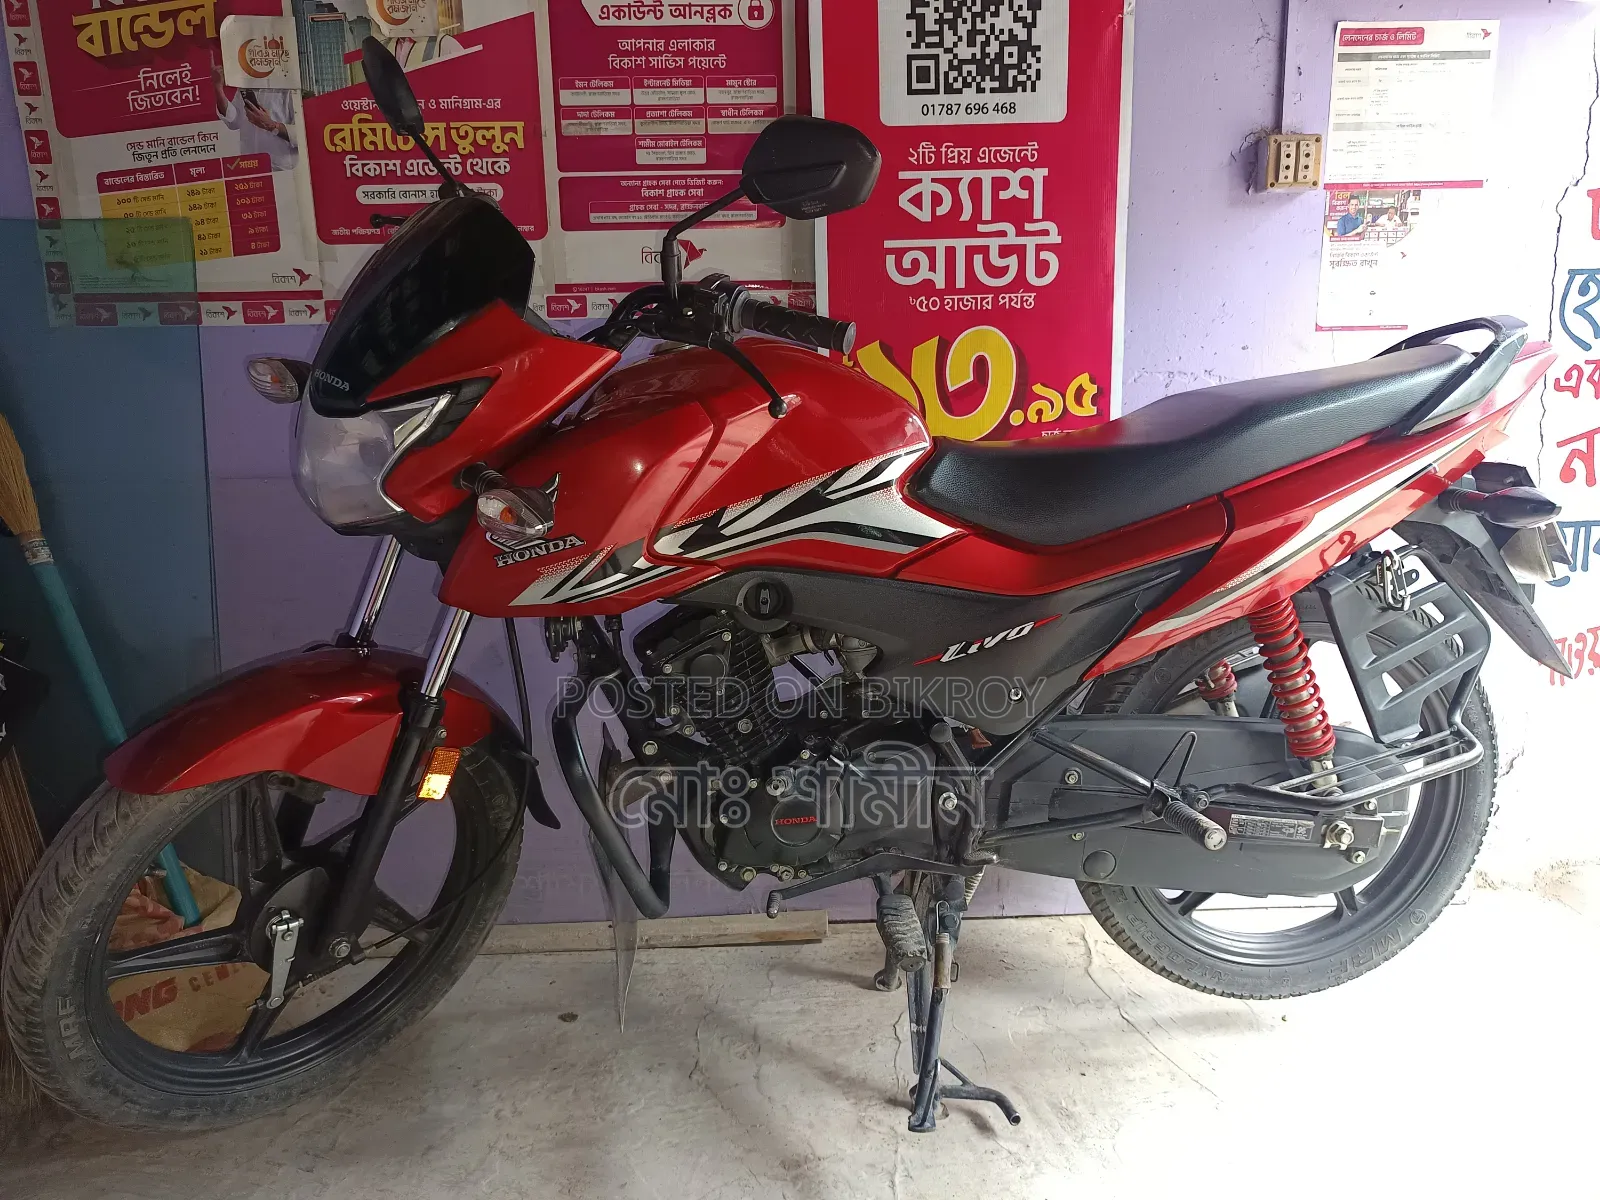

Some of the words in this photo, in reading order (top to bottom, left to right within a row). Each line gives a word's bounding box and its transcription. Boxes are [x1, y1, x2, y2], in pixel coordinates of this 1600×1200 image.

[598, 0, 664, 20] একাউন্ট
[668, 2, 734, 23] আনব্লক
[72, 0, 217, 57] বান্ডেল
[618, 38, 665, 52] আপনার
[668, 38, 716, 52] এলাকার
[608, 54, 646, 69] বিকাশ
[648, 54, 685, 68] সার্ভিস
[688, 54, 726, 70] পয়েন্টে
[138, 62, 191, 91] নিলেই
[127, 85, 200, 112] জিতবেন!
[439, 96, 501, 110] মানিগ্রাম-এর
[922, 103, 961, 116] 01787
[965, 102, 989, 115] 696
[992, 102, 1017, 115] 468
[126, 141, 144, 152] সেন্ড
[146, 136, 165, 150] মানি
[168, 134, 194, 147] বান্ডেল
[198, 132, 219, 142] কিনে
[450, 121, 524, 155] তুলুন
[132, 150, 158, 163] জিতুন
[161, 148, 177, 160] প্রতি
[180, 144, 216, 156] লেনদেনে
[908, 142, 937, 165] ২টি
[940, 142, 972, 164] প্রিয়
[977, 142, 1038, 164] এজেন্টে
[344, 155, 402, 178] বিকাশ
[467, 156, 510, 176] থেকে
[362, 188, 396, 200] সরকারি
[400, 189, 426, 200] বোনাস
[641, 188, 664, 198] বিকাশ
[688, 188, 704, 197] সেবা
[898, 167, 1048, 222] ক্যাশ
[884, 221, 1062, 289] আউট
[272, 272, 296, 284] বিকাশ
[944, 294, 994, 311] হাজার
[998, 290, 1036, 310] পর্যন্ত
[494, 534, 586, 567] HONDA
[775, 816, 818, 826] HONDA
